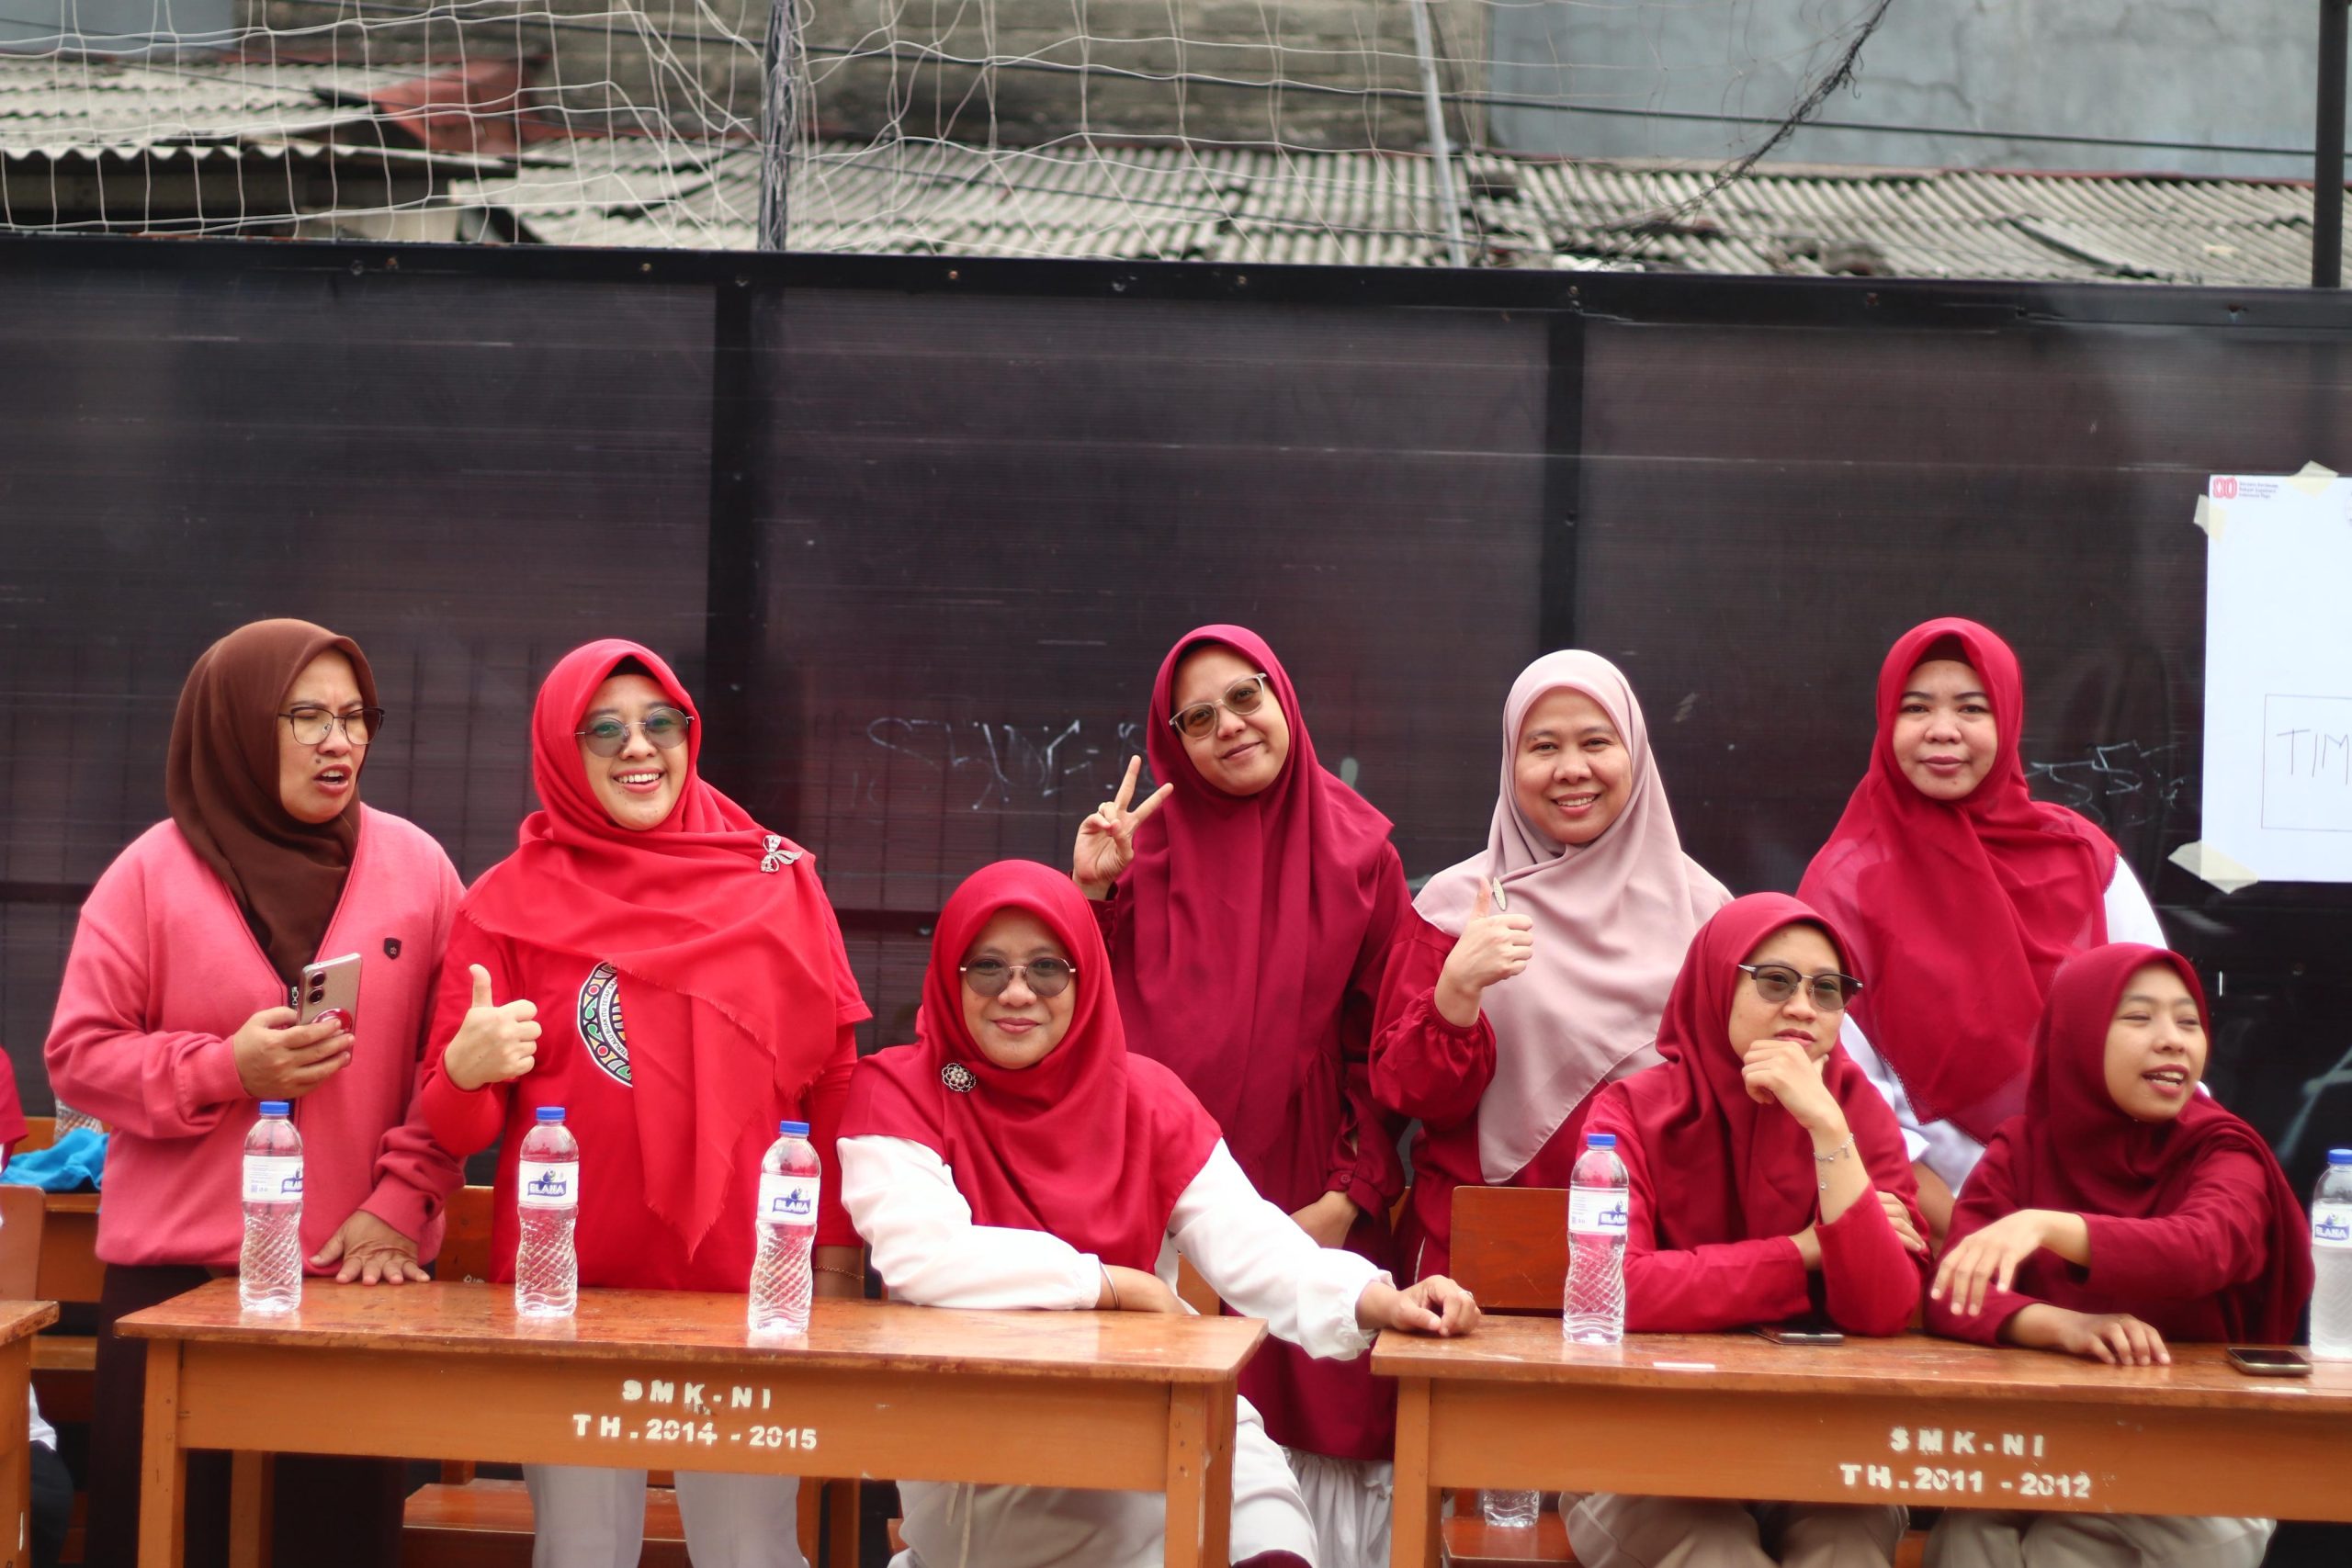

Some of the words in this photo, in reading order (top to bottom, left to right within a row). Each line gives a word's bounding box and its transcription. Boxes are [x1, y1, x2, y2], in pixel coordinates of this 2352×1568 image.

[2276, 728, 2350, 786] TIM
[601, 989, 611, 1007] TETAP
[602, 1019, 612, 1034] BIJAK
[607, 1034, 628, 1056] TERLALU
